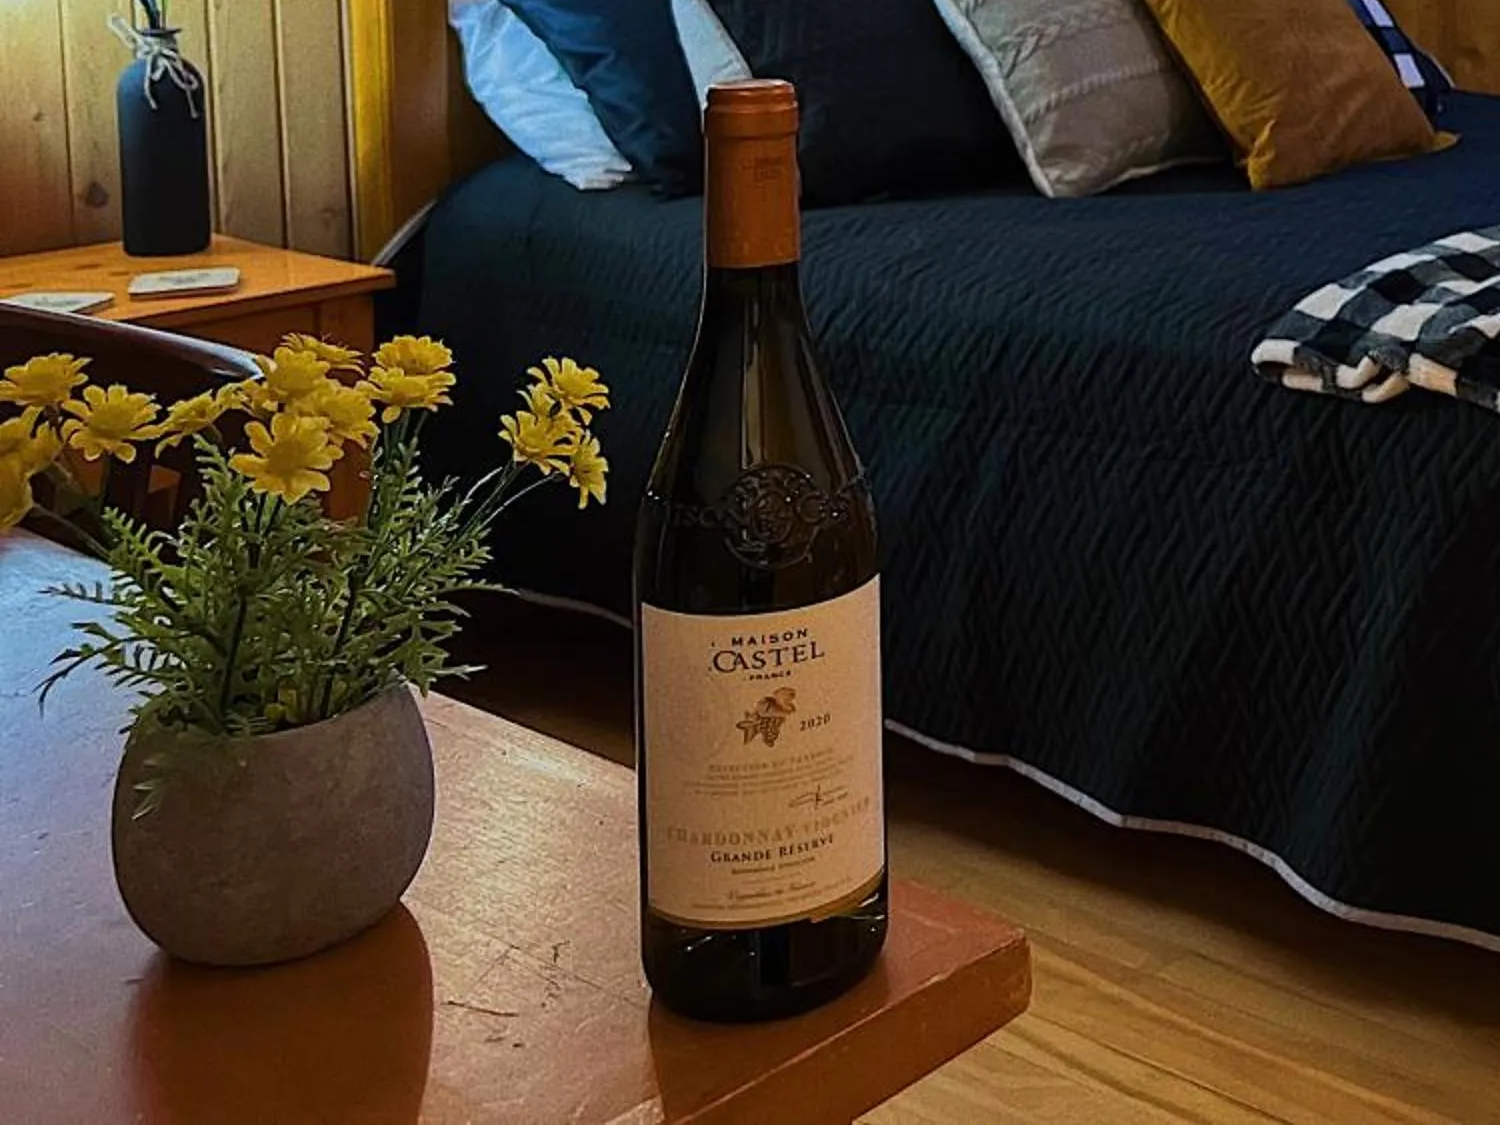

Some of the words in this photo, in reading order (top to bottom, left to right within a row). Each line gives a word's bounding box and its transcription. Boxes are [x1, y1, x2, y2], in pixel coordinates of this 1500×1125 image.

[731, 627, 808, 646] MAISON
[713, 640, 825, 673] CASTEL
[799, 713, 832, 732] 2020
[711, 848, 771, 864] GRANDE
